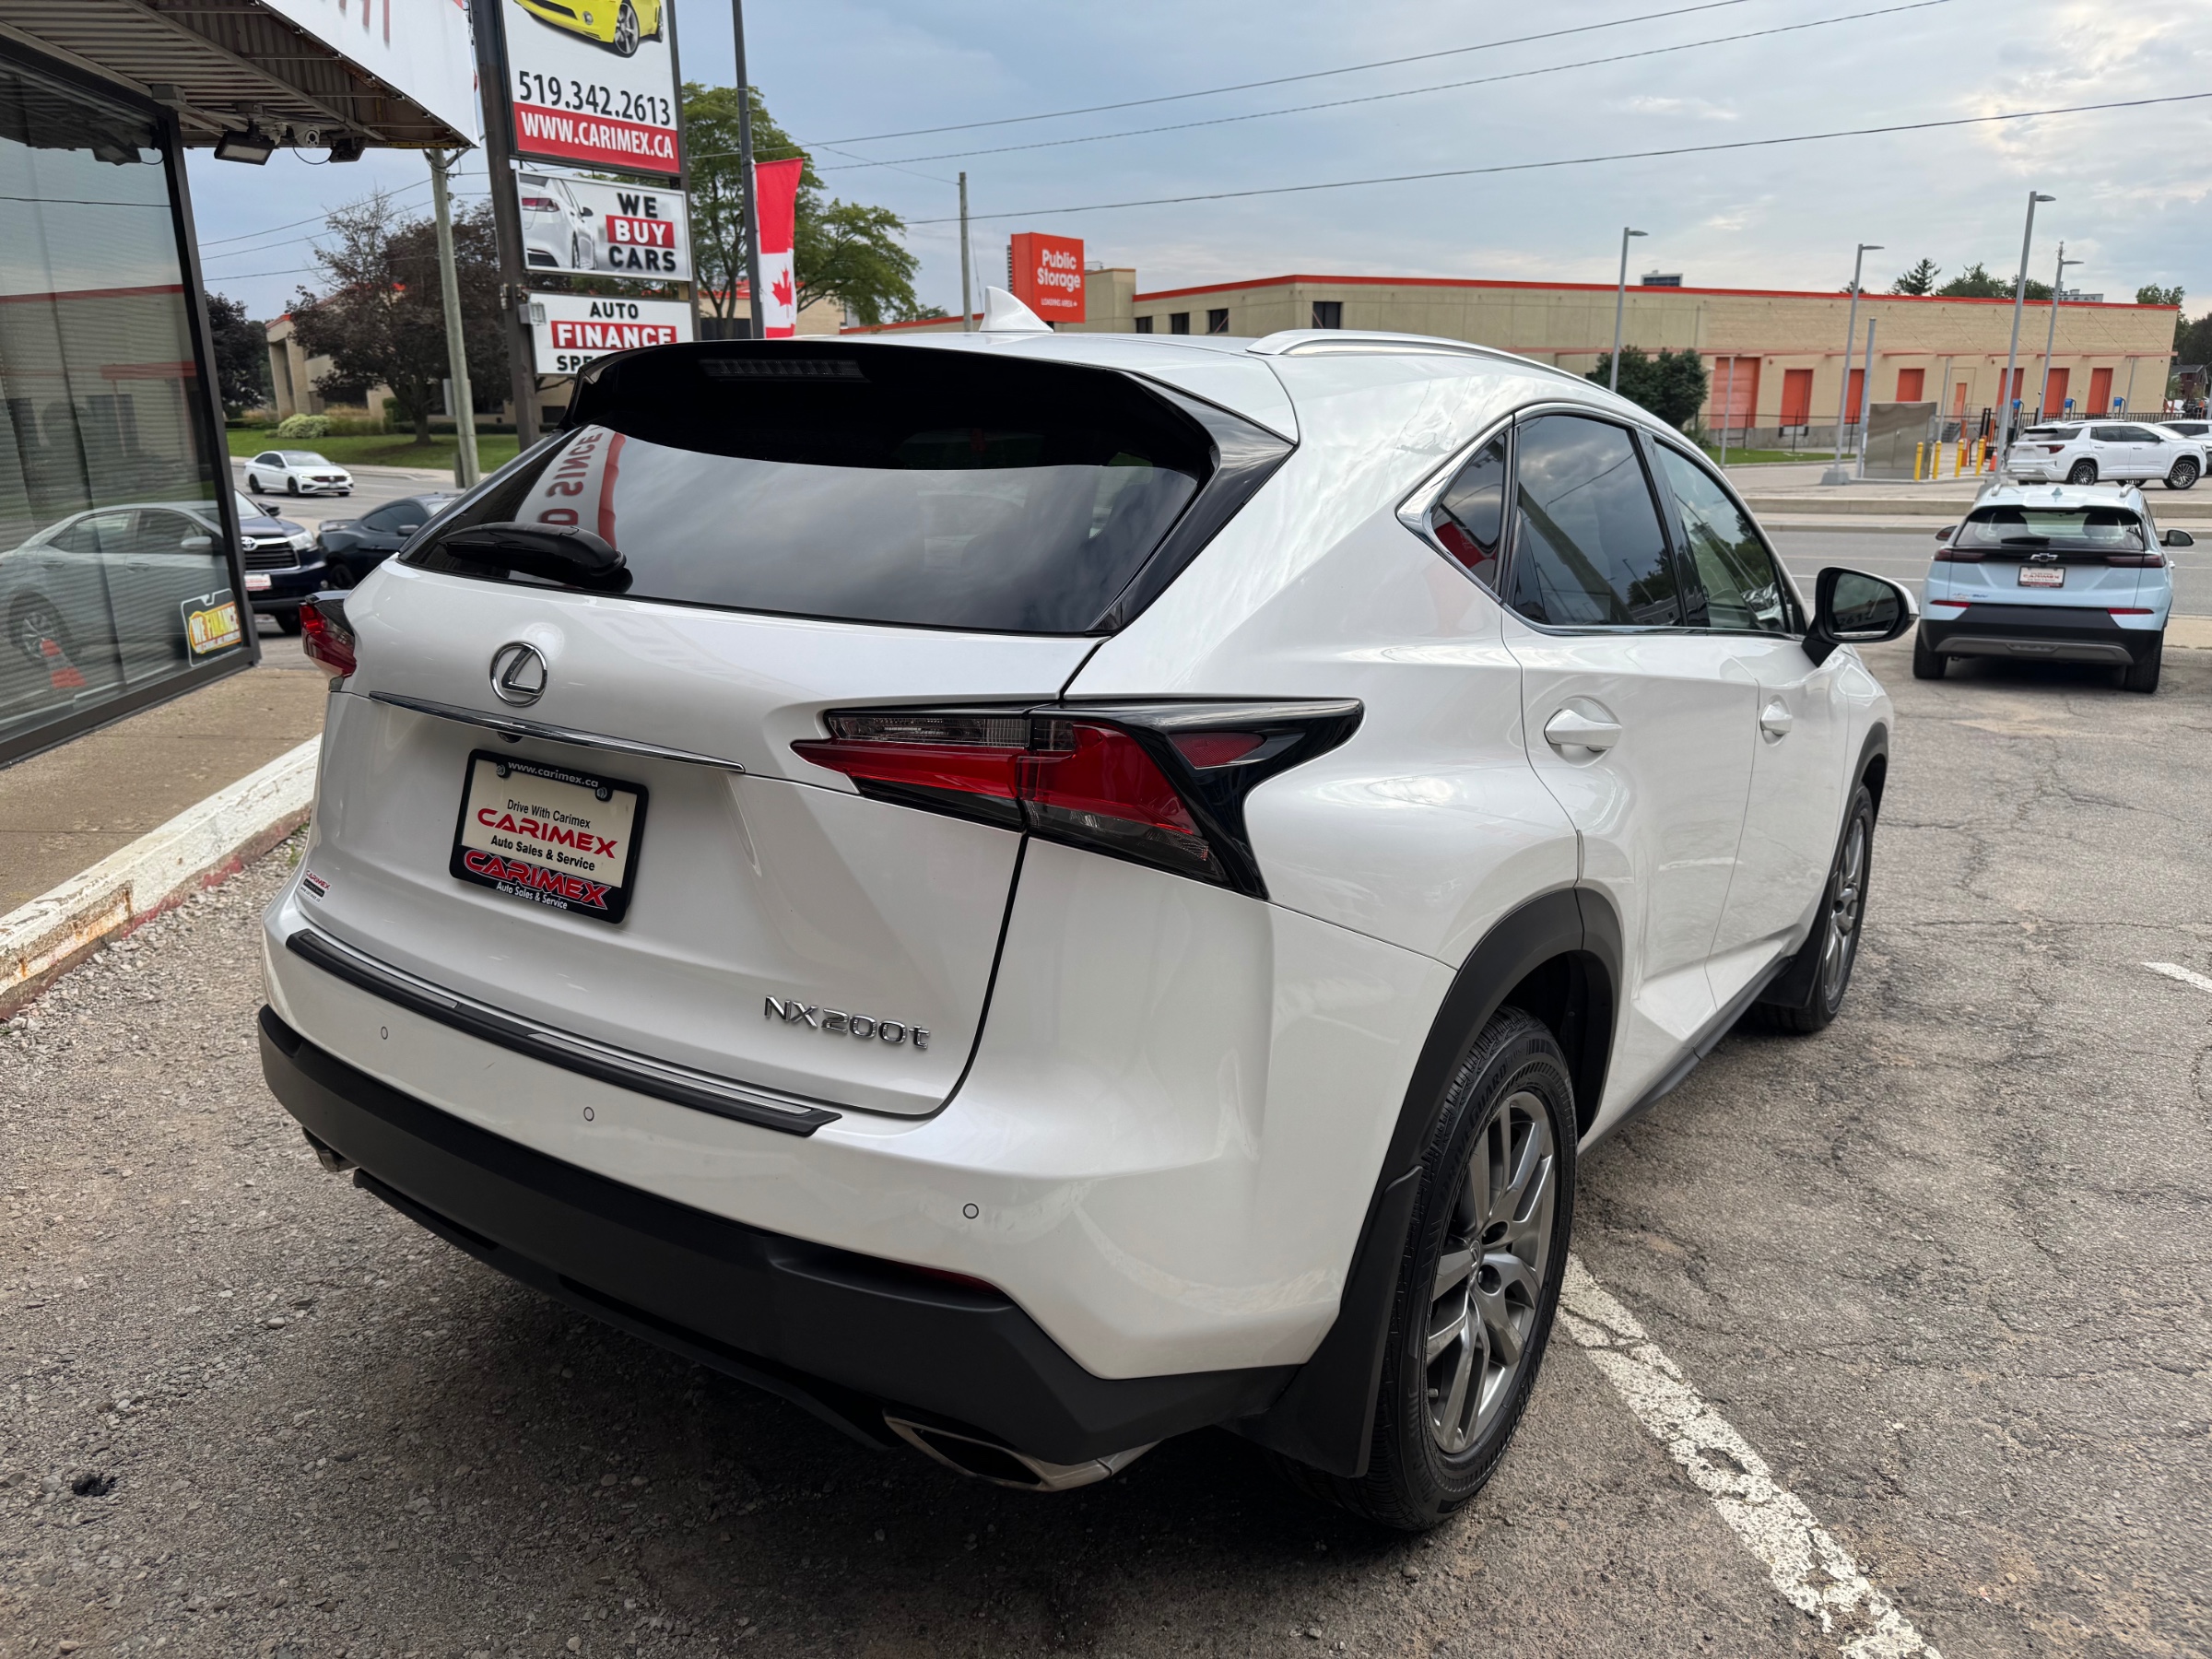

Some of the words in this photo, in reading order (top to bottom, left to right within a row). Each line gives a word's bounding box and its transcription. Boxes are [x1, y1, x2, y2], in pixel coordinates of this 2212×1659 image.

[519, 70, 670, 126] 519.342.2613
[521, 111, 674, 159] WWW.CARIMEX.CA
[617, 193, 658, 218] WE
[615, 218, 666, 245] BUY
[608, 245, 677, 273] CARS
[1041, 249, 1077, 270] Public
[1037, 267, 1081, 293] Storage
[590, 301, 639, 320] AUTO
[557, 324, 672, 347] FINANCE
[508, 761, 599, 788] www.carimex.ca
[507, 799, 529, 814] Drive
[531, 804, 550, 819] With
[552, 810, 592, 830] Carimex
[477, 807, 618, 859] CARIMEX
[490, 834, 513, 850] Auto
[515, 841, 543, 859] Sales
[546, 848, 554, 861] &
[556, 851, 595, 872] Service
[464, 849, 612, 911] CARIMEX
[496, 881, 513, 894] Auto
[514, 886, 534, 900] Sales
[535, 891, 541, 901] &
[541, 893, 568, 910] Service
